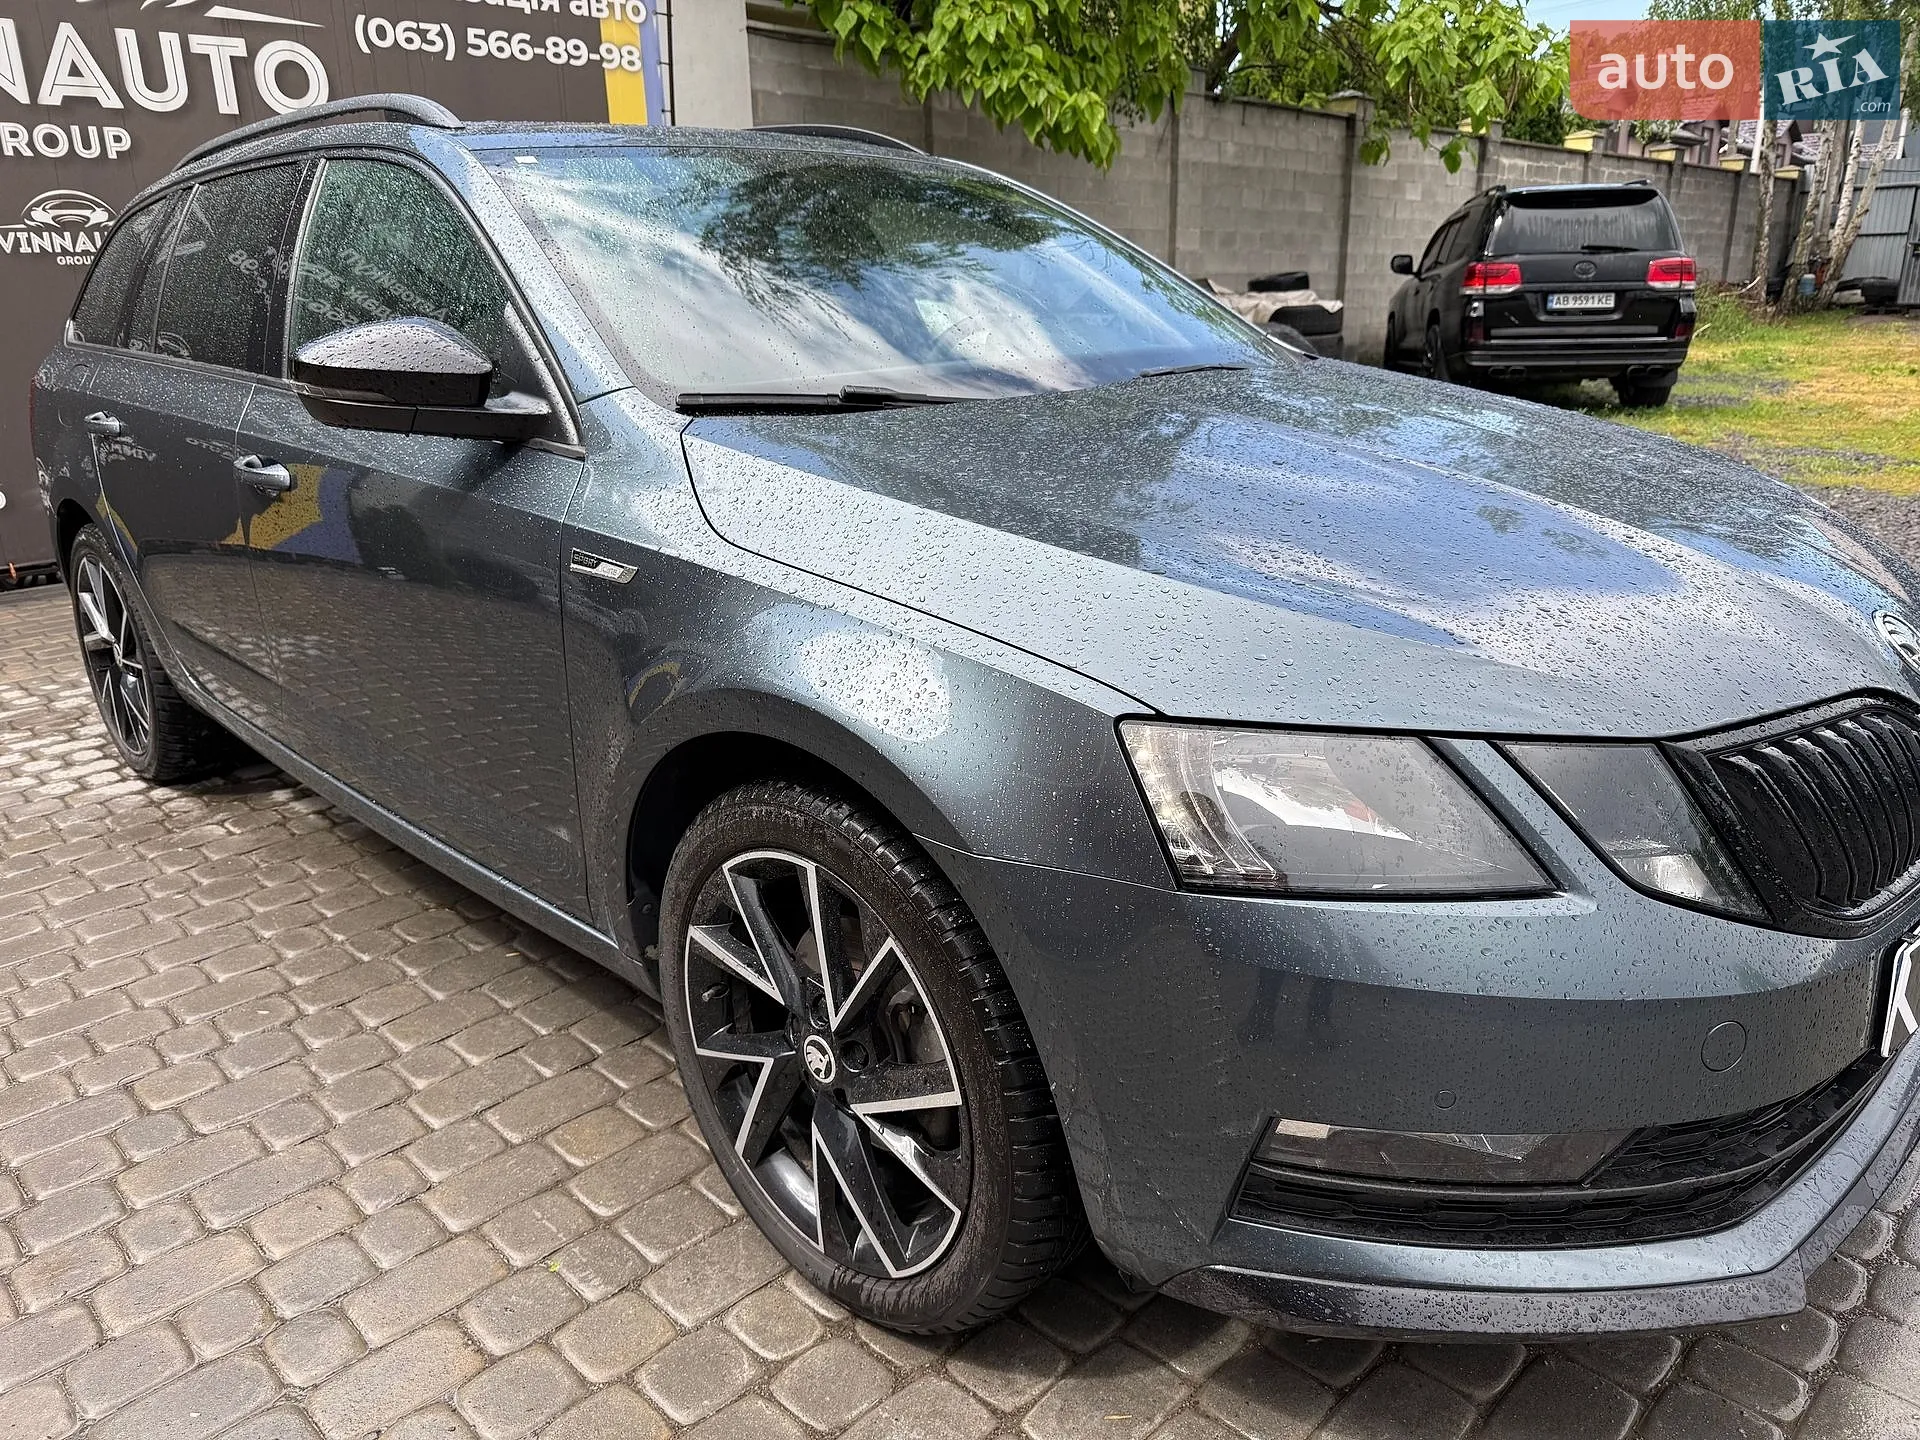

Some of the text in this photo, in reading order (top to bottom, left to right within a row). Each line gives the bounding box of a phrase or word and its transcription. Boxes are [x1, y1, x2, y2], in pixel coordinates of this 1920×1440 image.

[355, 14, 642, 72] (063) 566-89-98
[56, 255, 95, 266] GROU
[1554, 295, 1570, 306] AB
[1597, 294, 1613, 305] KE
